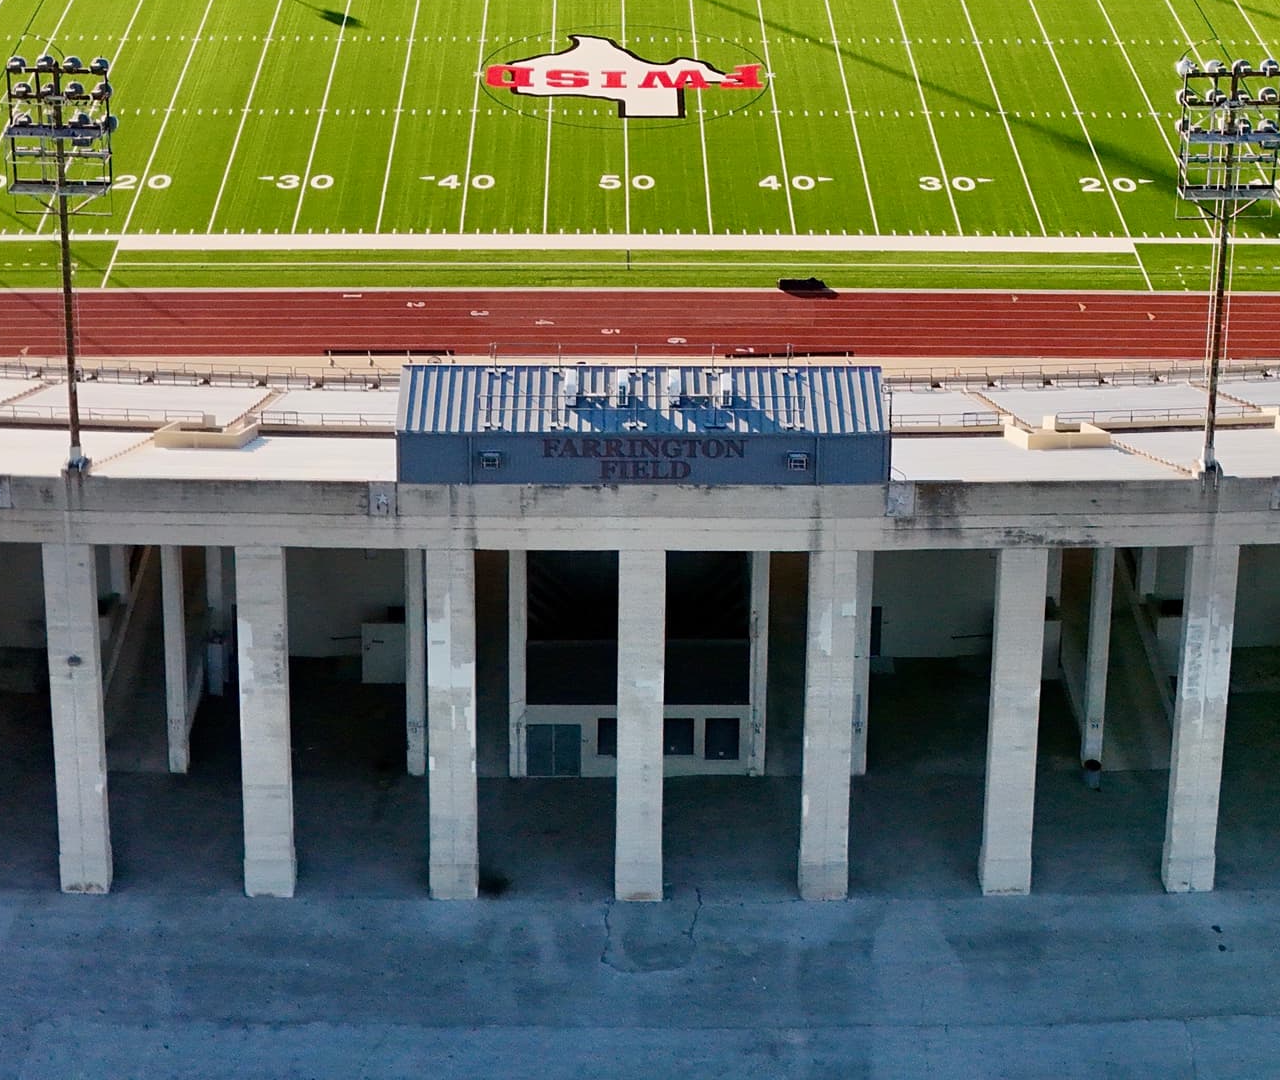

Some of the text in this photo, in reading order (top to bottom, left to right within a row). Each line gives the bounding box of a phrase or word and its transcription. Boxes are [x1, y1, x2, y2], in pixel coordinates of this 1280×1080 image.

[486, 63, 764, 89] FWISD
[112, 175, 172, 190] 20
[276, 174, 334, 190] 30
[437, 174, 495, 190] 40
[599, 174, 655, 190] 50
[758, 175, 816, 190] 40
[919, 176, 977, 191] 30
[1079, 177, 1137, 192] 20
[542, 438, 748, 458] FARRINGTON
[598, 460, 692, 480] FIELD
